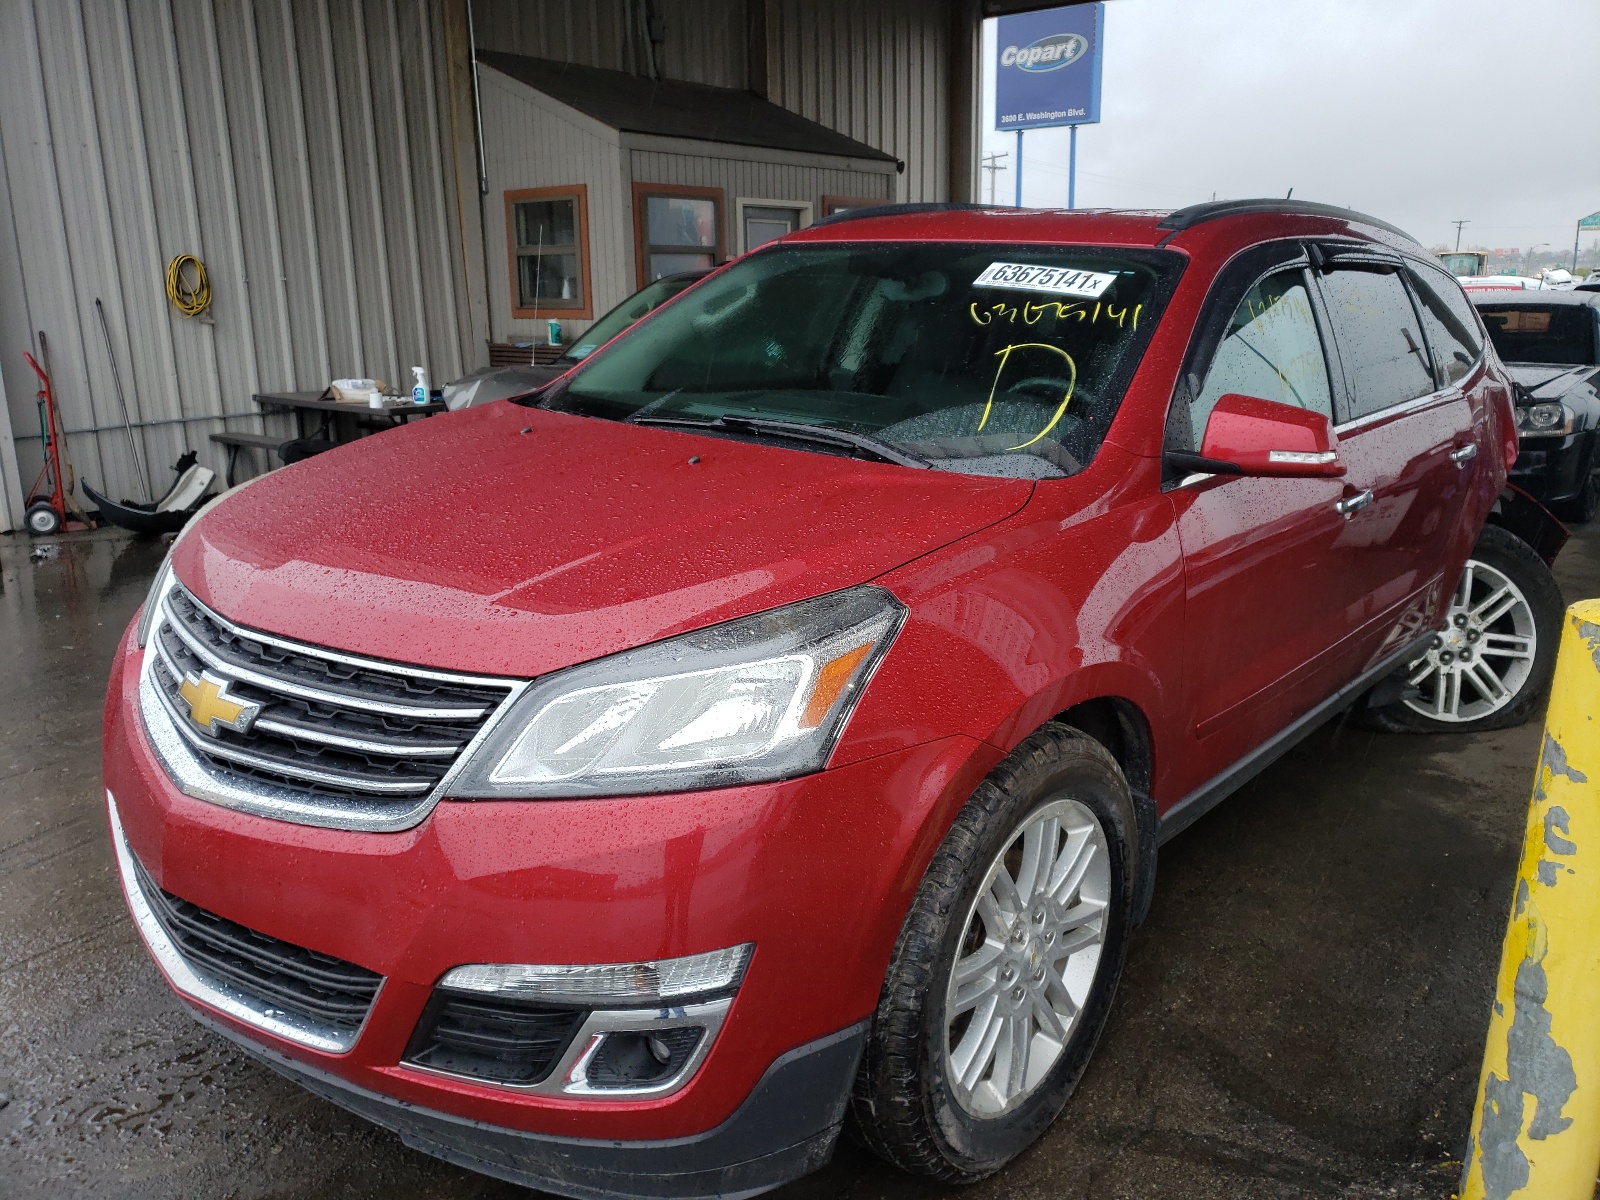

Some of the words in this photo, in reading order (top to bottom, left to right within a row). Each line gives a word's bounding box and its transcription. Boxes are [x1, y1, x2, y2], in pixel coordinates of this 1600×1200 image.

[1000, 36, 1078, 68] Copart
[1018, 113, 1026, 121] E.
[1026, 109, 1067, 120] Washington
[1067, 107, 1087, 117] Blvd.
[977, 343, 1077, 452] D
